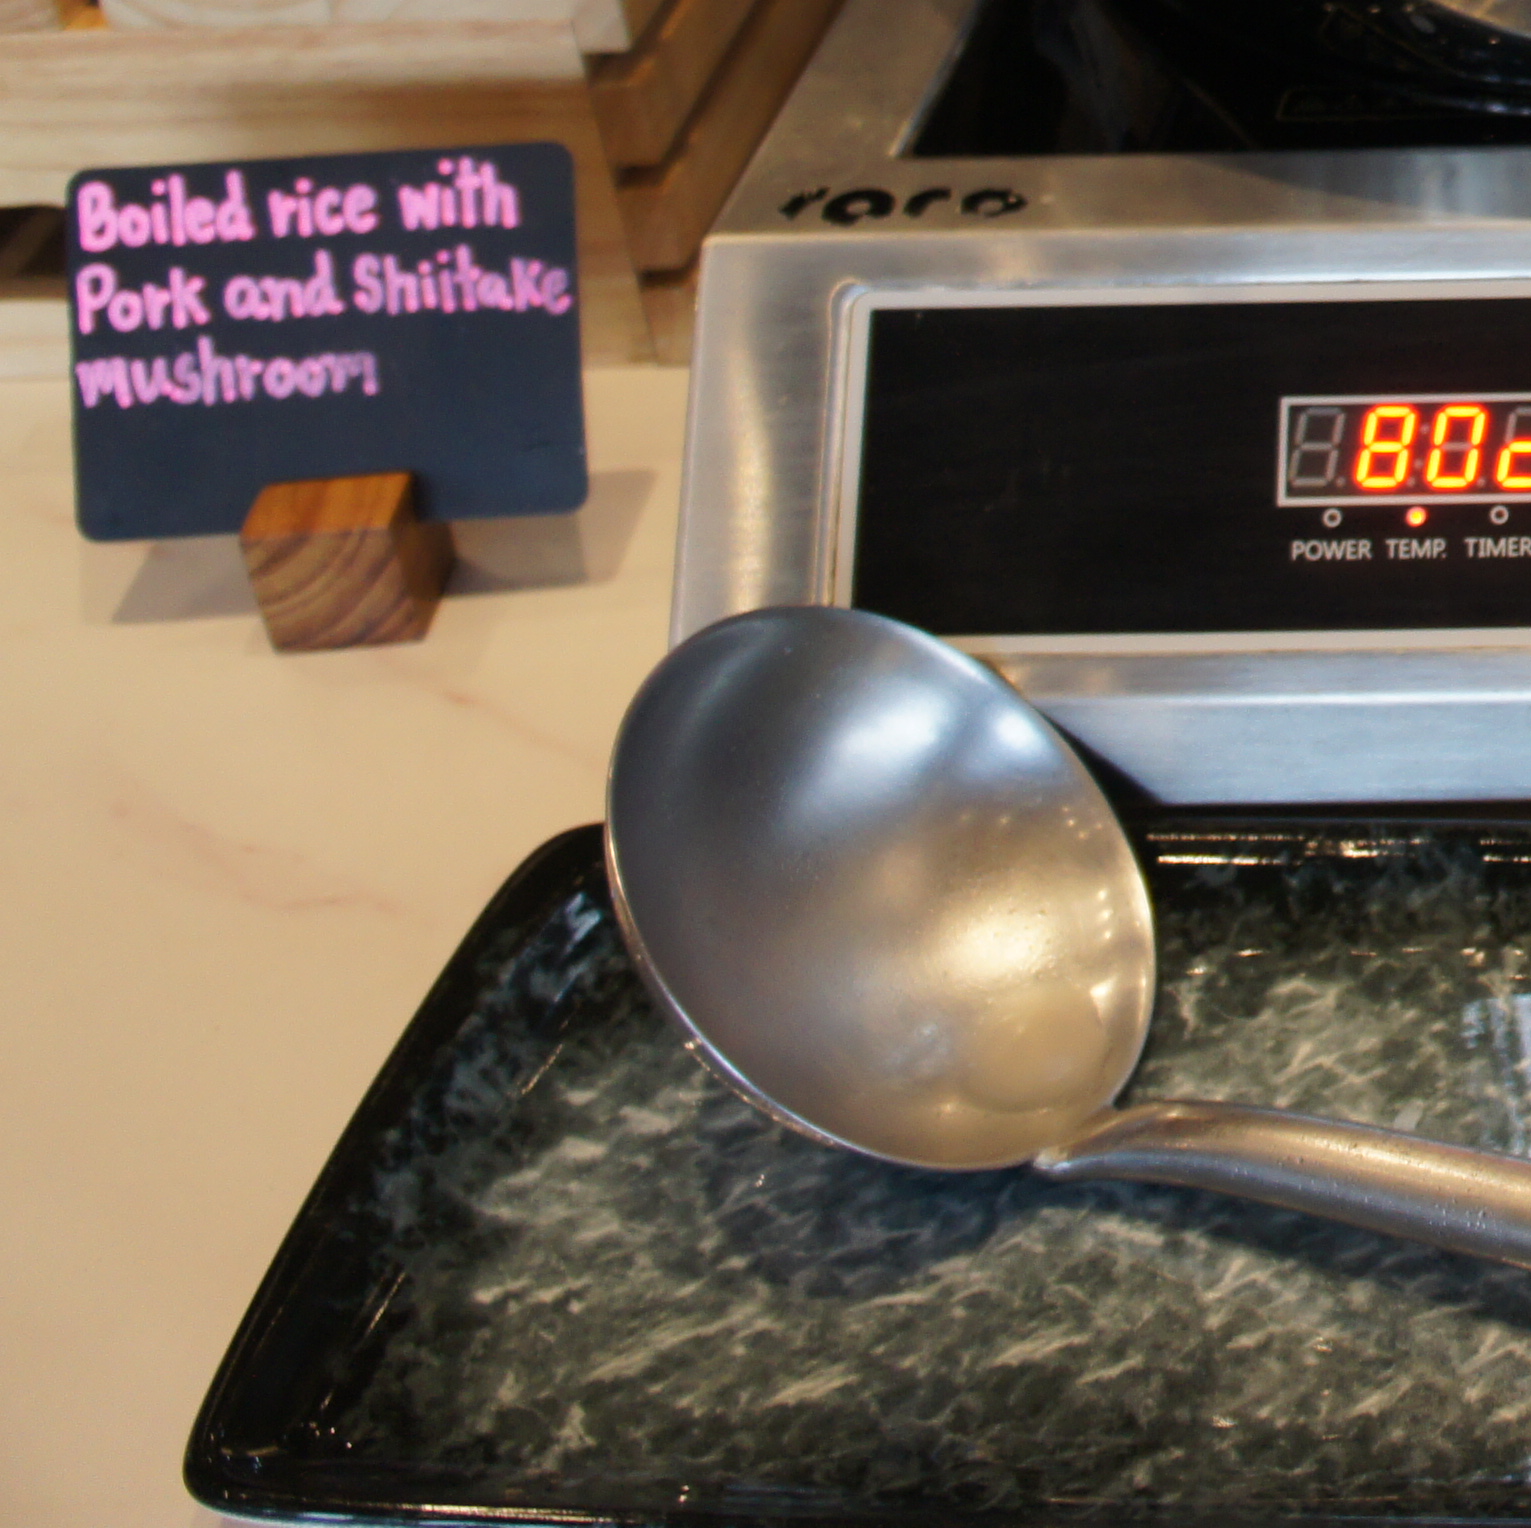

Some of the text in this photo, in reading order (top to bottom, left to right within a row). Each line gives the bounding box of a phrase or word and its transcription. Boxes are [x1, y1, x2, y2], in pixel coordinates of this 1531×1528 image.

[77, 156, 521, 252] Boiled rice with
[76, 243, 574, 335] Pork and Shiitake
[75, 336, 380, 409] mushroom
[1291, 539, 1372, 561] POWER
[1386, 538, 1447, 560] TEMP.
